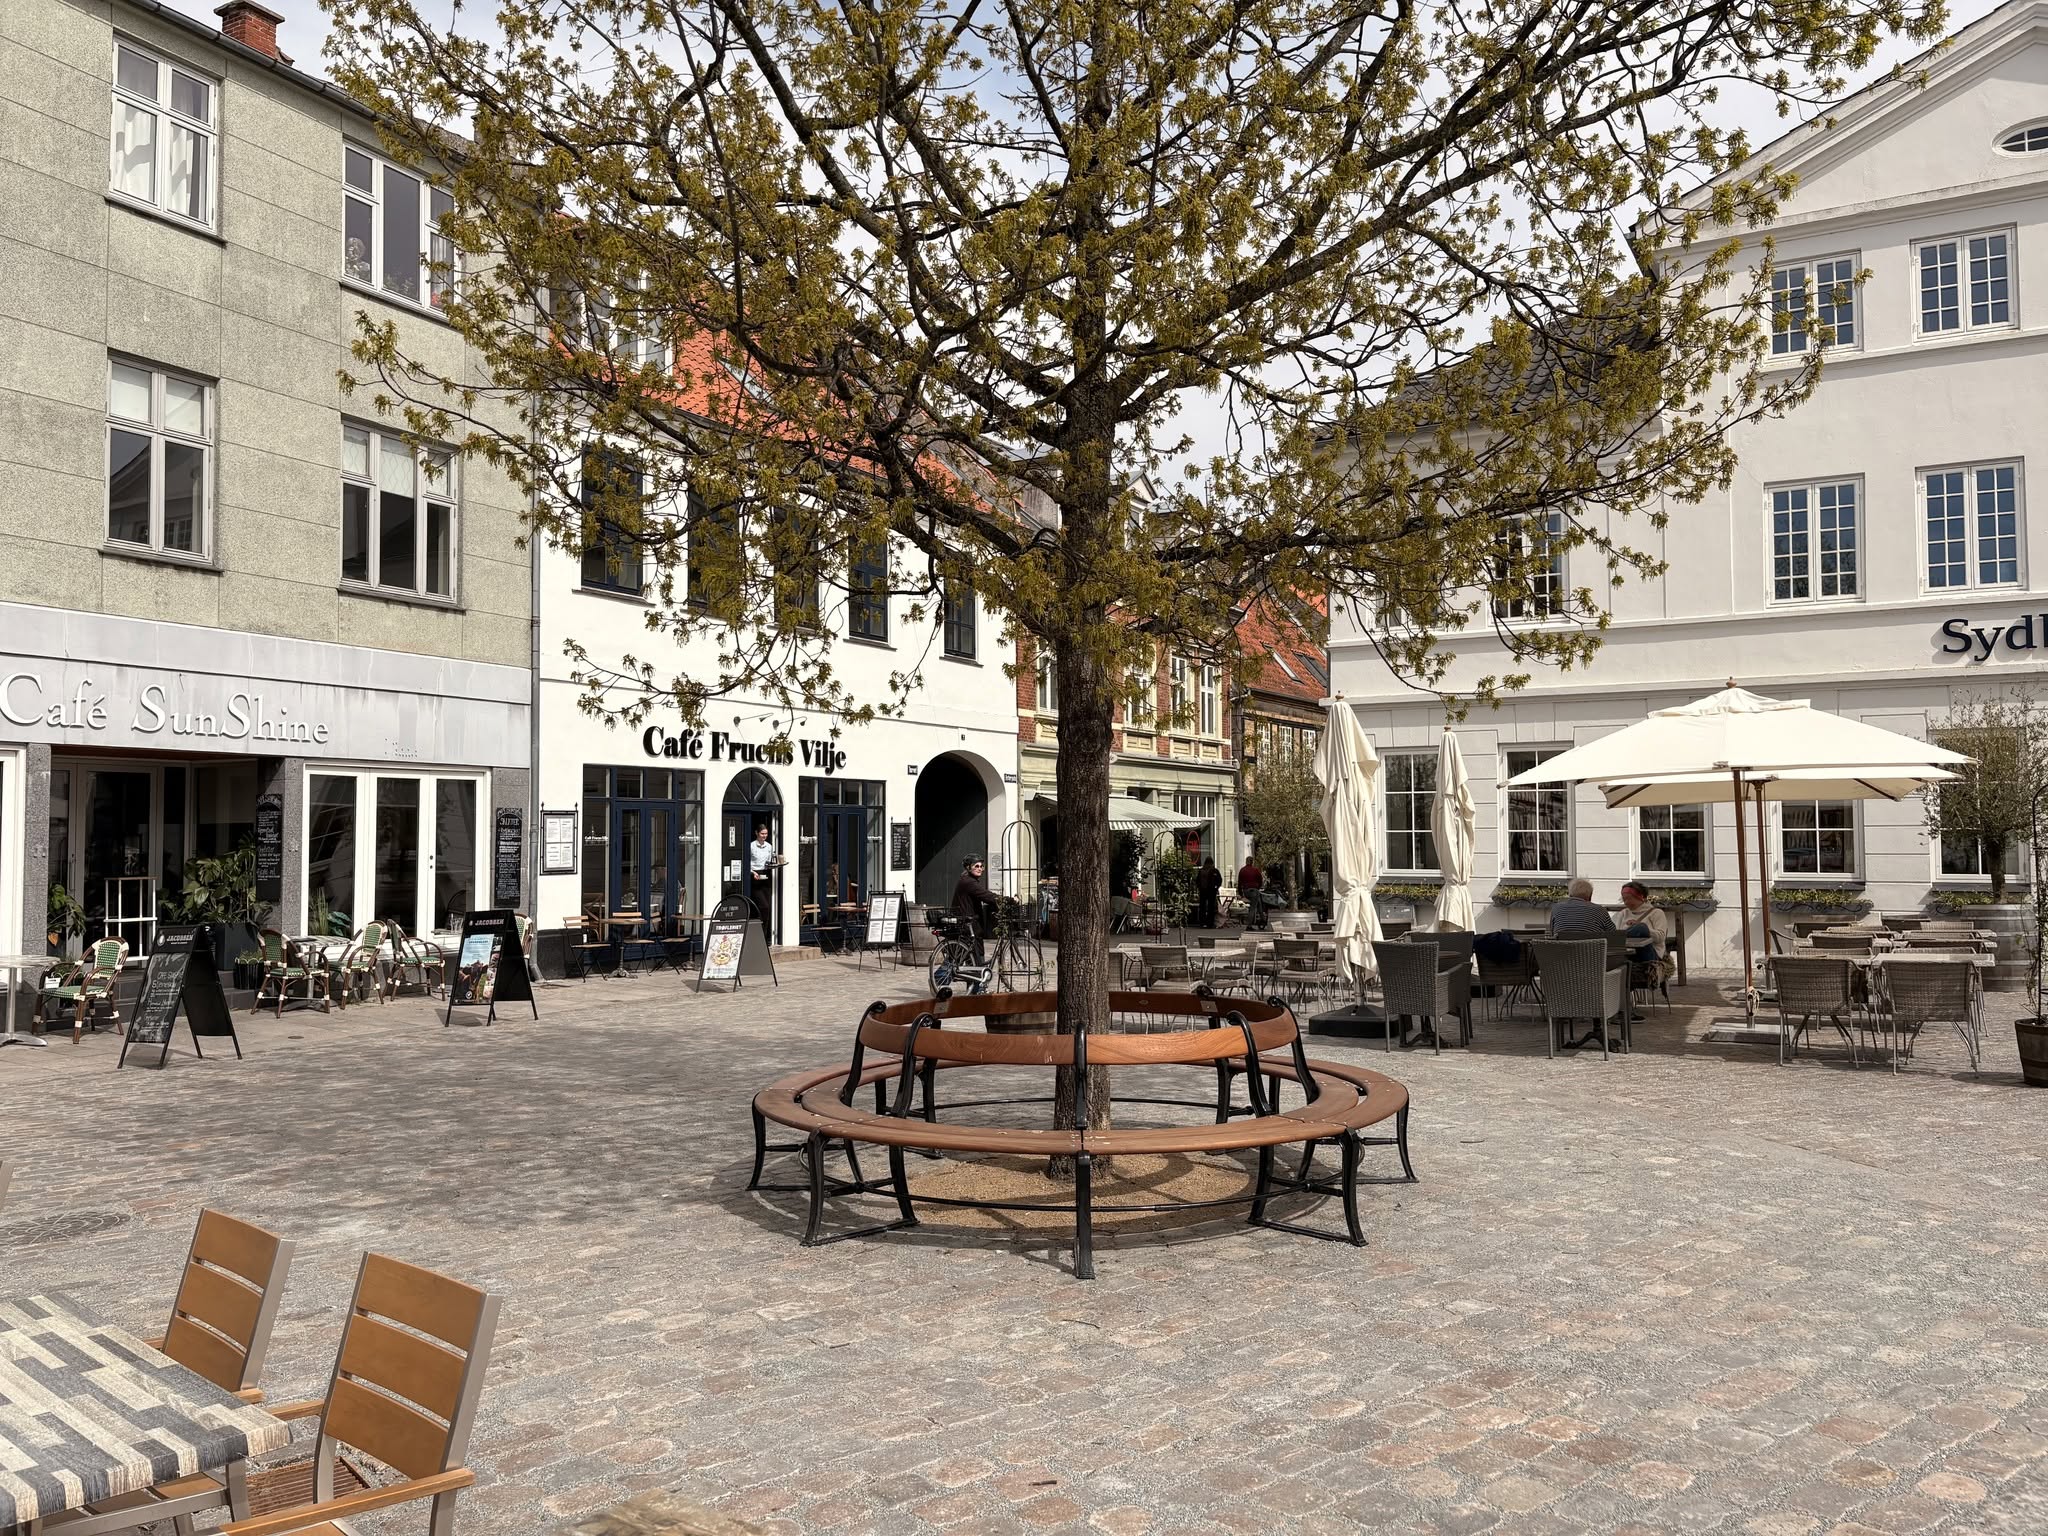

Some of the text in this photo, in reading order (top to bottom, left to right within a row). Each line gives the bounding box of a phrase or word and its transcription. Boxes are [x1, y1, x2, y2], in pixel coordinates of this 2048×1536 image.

[0, 672, 329, 744] Café SunShine
[642, 725, 704, 759] Café
[799, 739, 847, 775] Vilje
